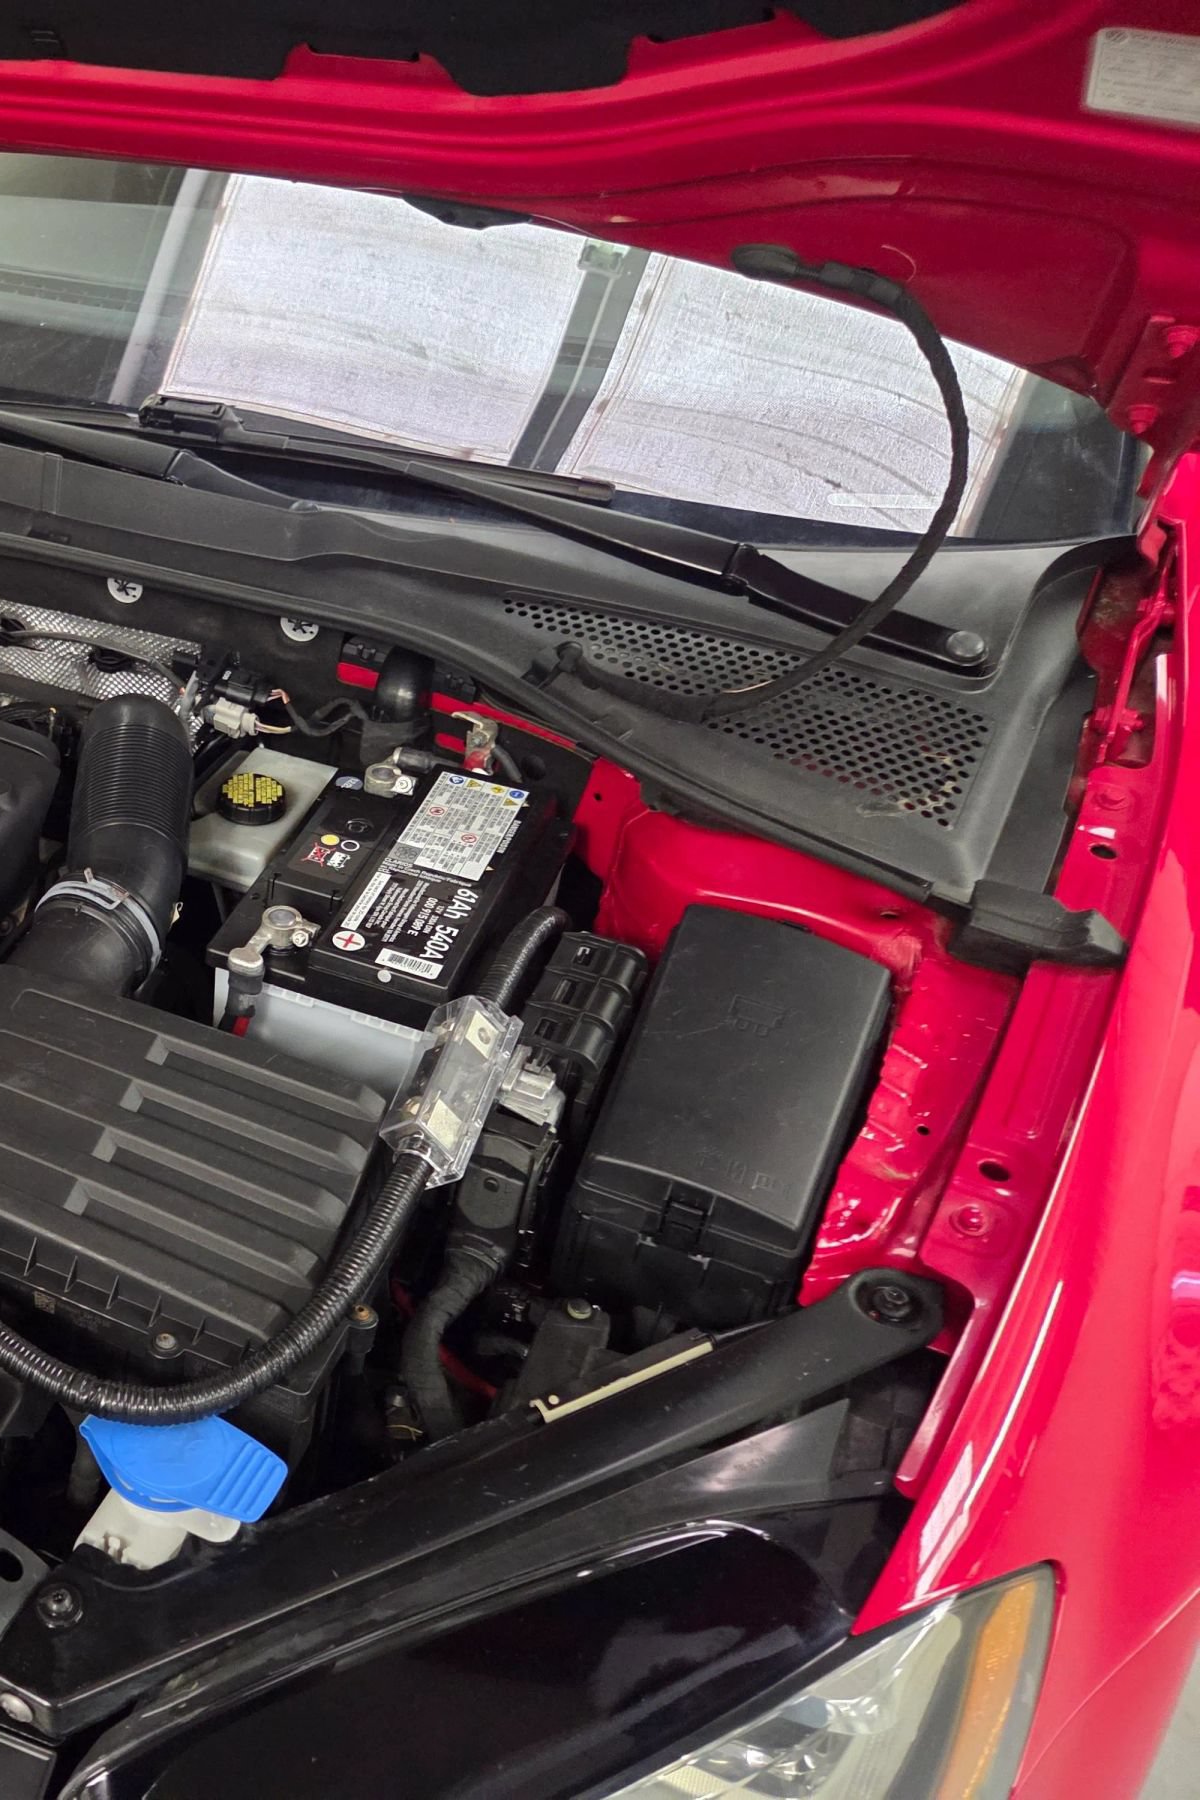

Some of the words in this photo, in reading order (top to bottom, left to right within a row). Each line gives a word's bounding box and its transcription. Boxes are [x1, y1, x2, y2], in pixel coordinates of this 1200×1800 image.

[424, 897, 438, 908] 000
[443, 888, 479, 918] 61Ah
[418, 908, 431, 919] 915
[419, 925, 459, 959] 540A
